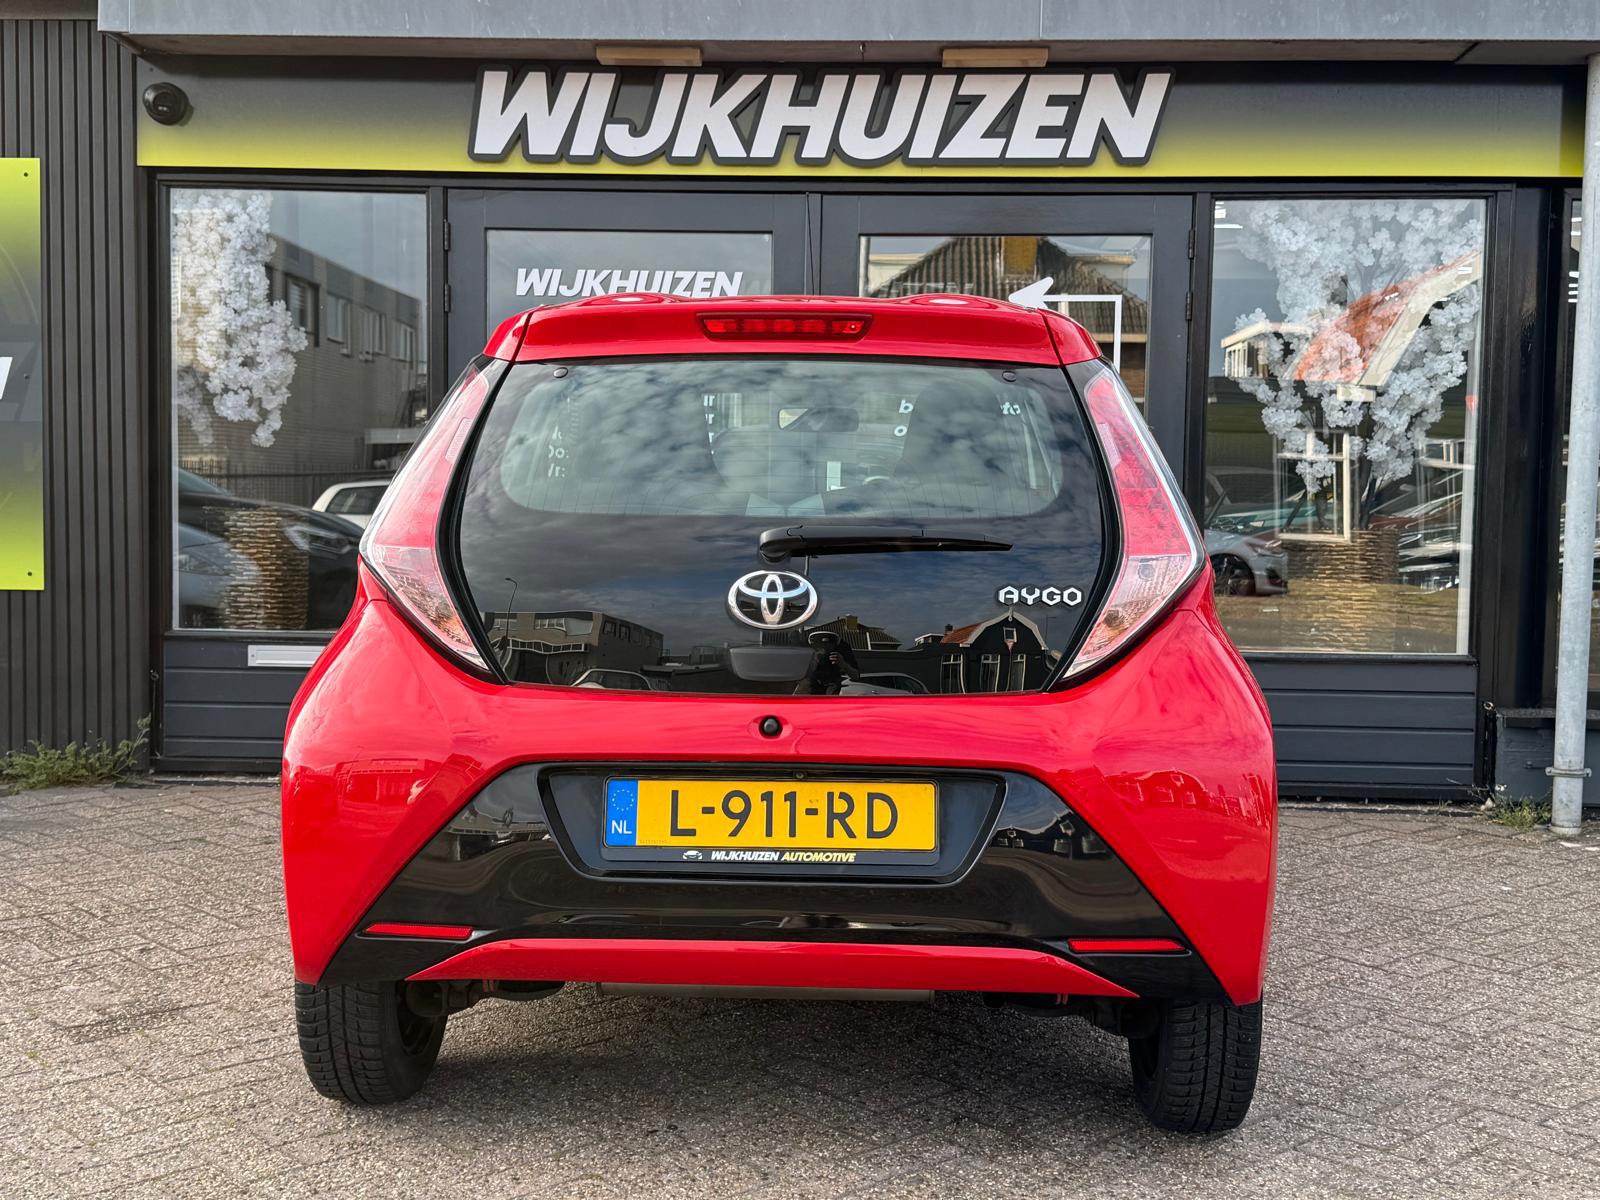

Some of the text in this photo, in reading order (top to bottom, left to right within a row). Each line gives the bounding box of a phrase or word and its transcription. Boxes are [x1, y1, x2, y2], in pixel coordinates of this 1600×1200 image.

[473, 71, 1171, 160] WIJKHUIZEN
[515, 267, 743, 297] WIJKHUIZEN
[998, 585, 1082, 606] AYGO
[670, 789, 898, 839] L-911-RD
[611, 819, 632, 835] NL
[711, 850, 857, 863] WIJKHUIZEN AUTOMOTIVE
